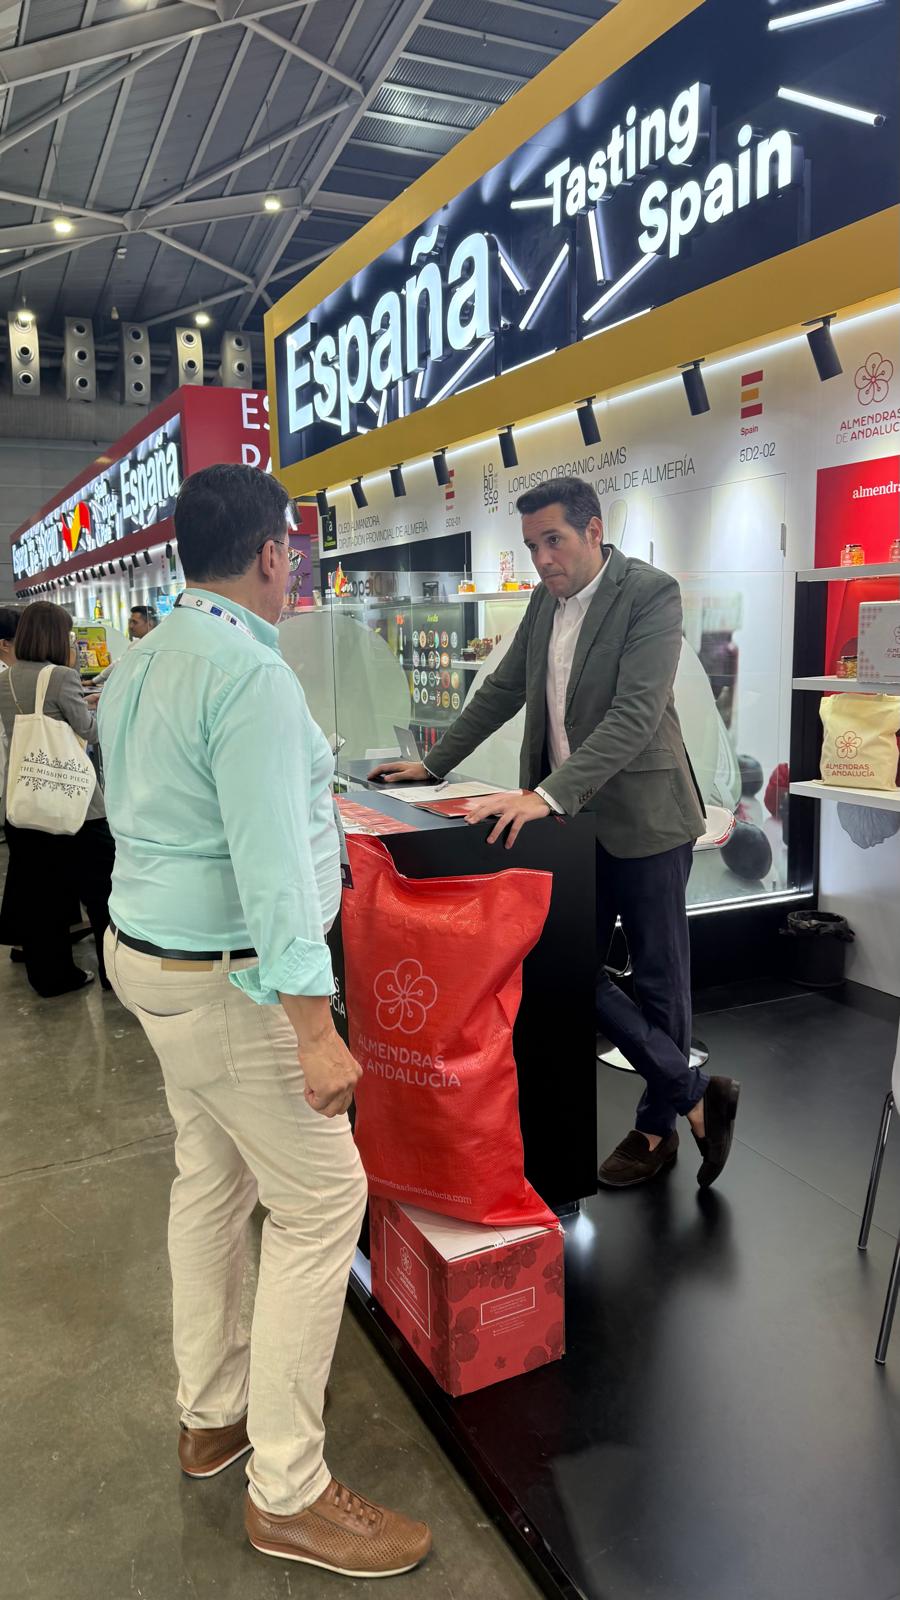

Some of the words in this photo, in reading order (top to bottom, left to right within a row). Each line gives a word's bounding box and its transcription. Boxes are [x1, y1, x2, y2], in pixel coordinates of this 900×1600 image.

[545, 82, 700, 227] Tasting
[637, 124, 792, 258] Spain
[287, 225, 493, 436] España
[740, 425, 759, 436] Spain
[850, 422, 900, 441] ANDALUC
[508, 469, 548, 493] LORUSSO
[550, 456, 595, 481] ORGANIC
[597, 446, 627, 470] JAMS
[739, 442, 776, 463] 5D2-02
[624, 470, 639, 490] DE
[641, 454, 696, 484] ALMERÍA
[36, 768, 68, 780] MISSING
[358, 1034, 444, 1070] ALMENDRAS
[367, 1060, 461, 1088] ANDALUCÍA
